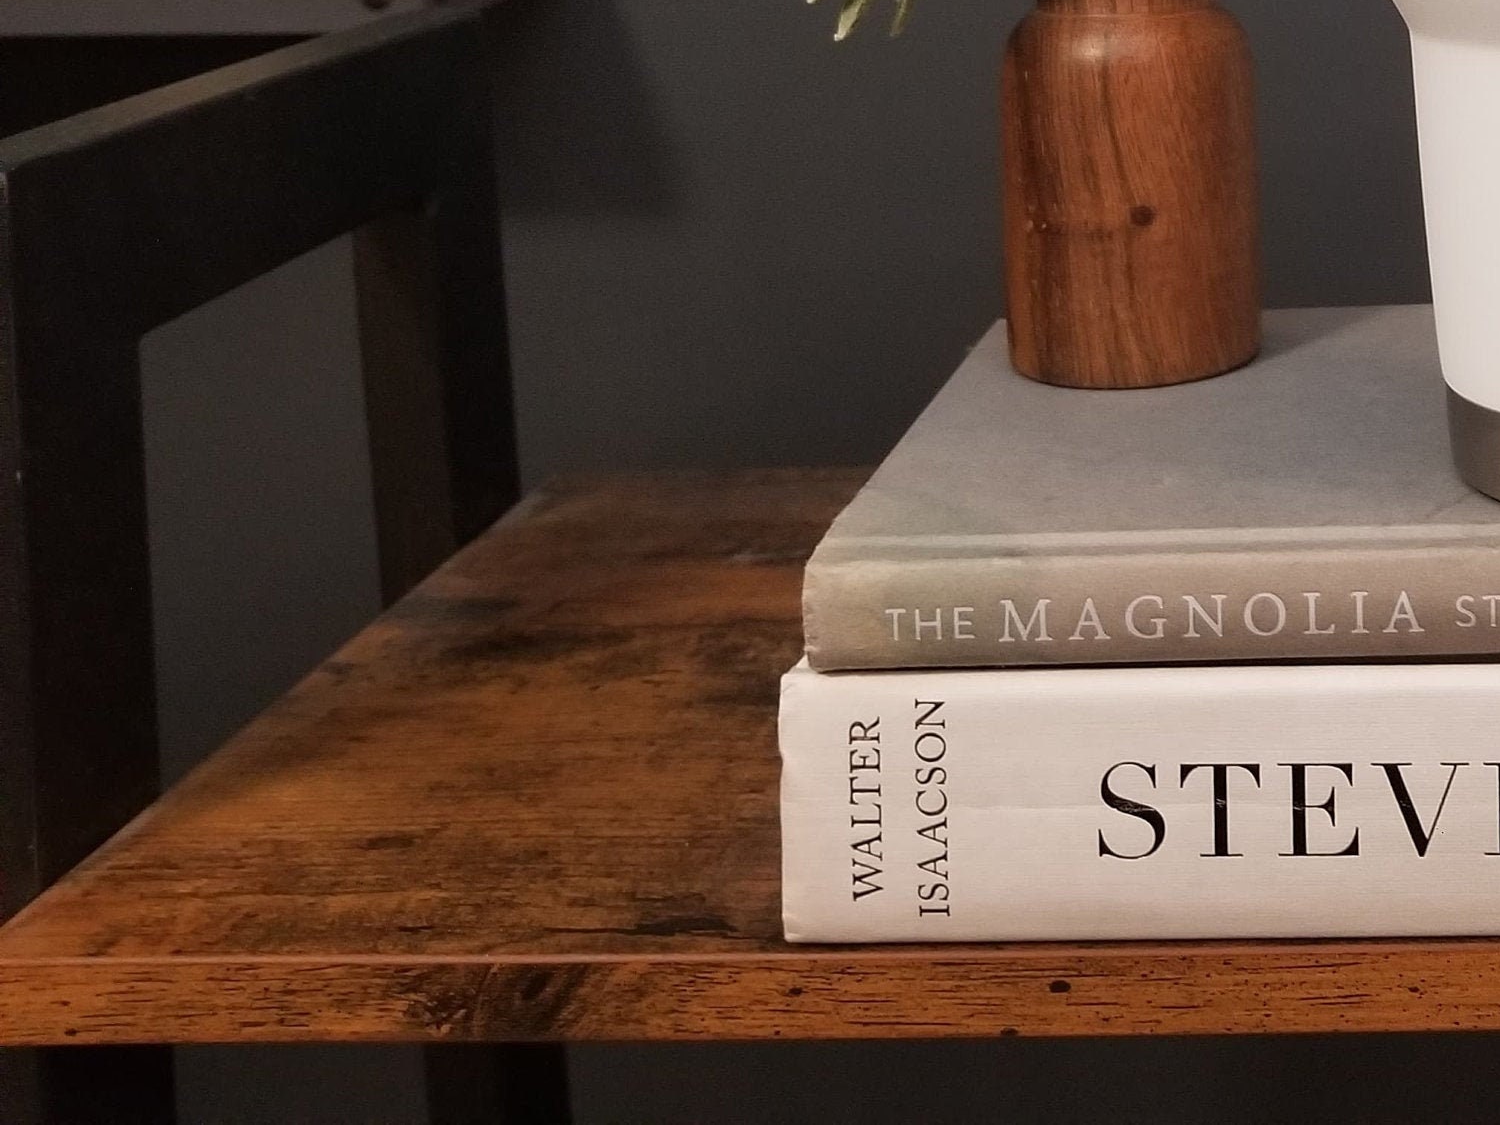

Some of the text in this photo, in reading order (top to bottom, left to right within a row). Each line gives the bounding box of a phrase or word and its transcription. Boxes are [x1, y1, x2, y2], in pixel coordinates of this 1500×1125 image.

[884, 606, 976, 641] THE
[1000, 590, 1425, 642] MAGNOLIA
[848, 716, 884, 902] WALTER
[914, 698, 950, 917] ISAACSON
